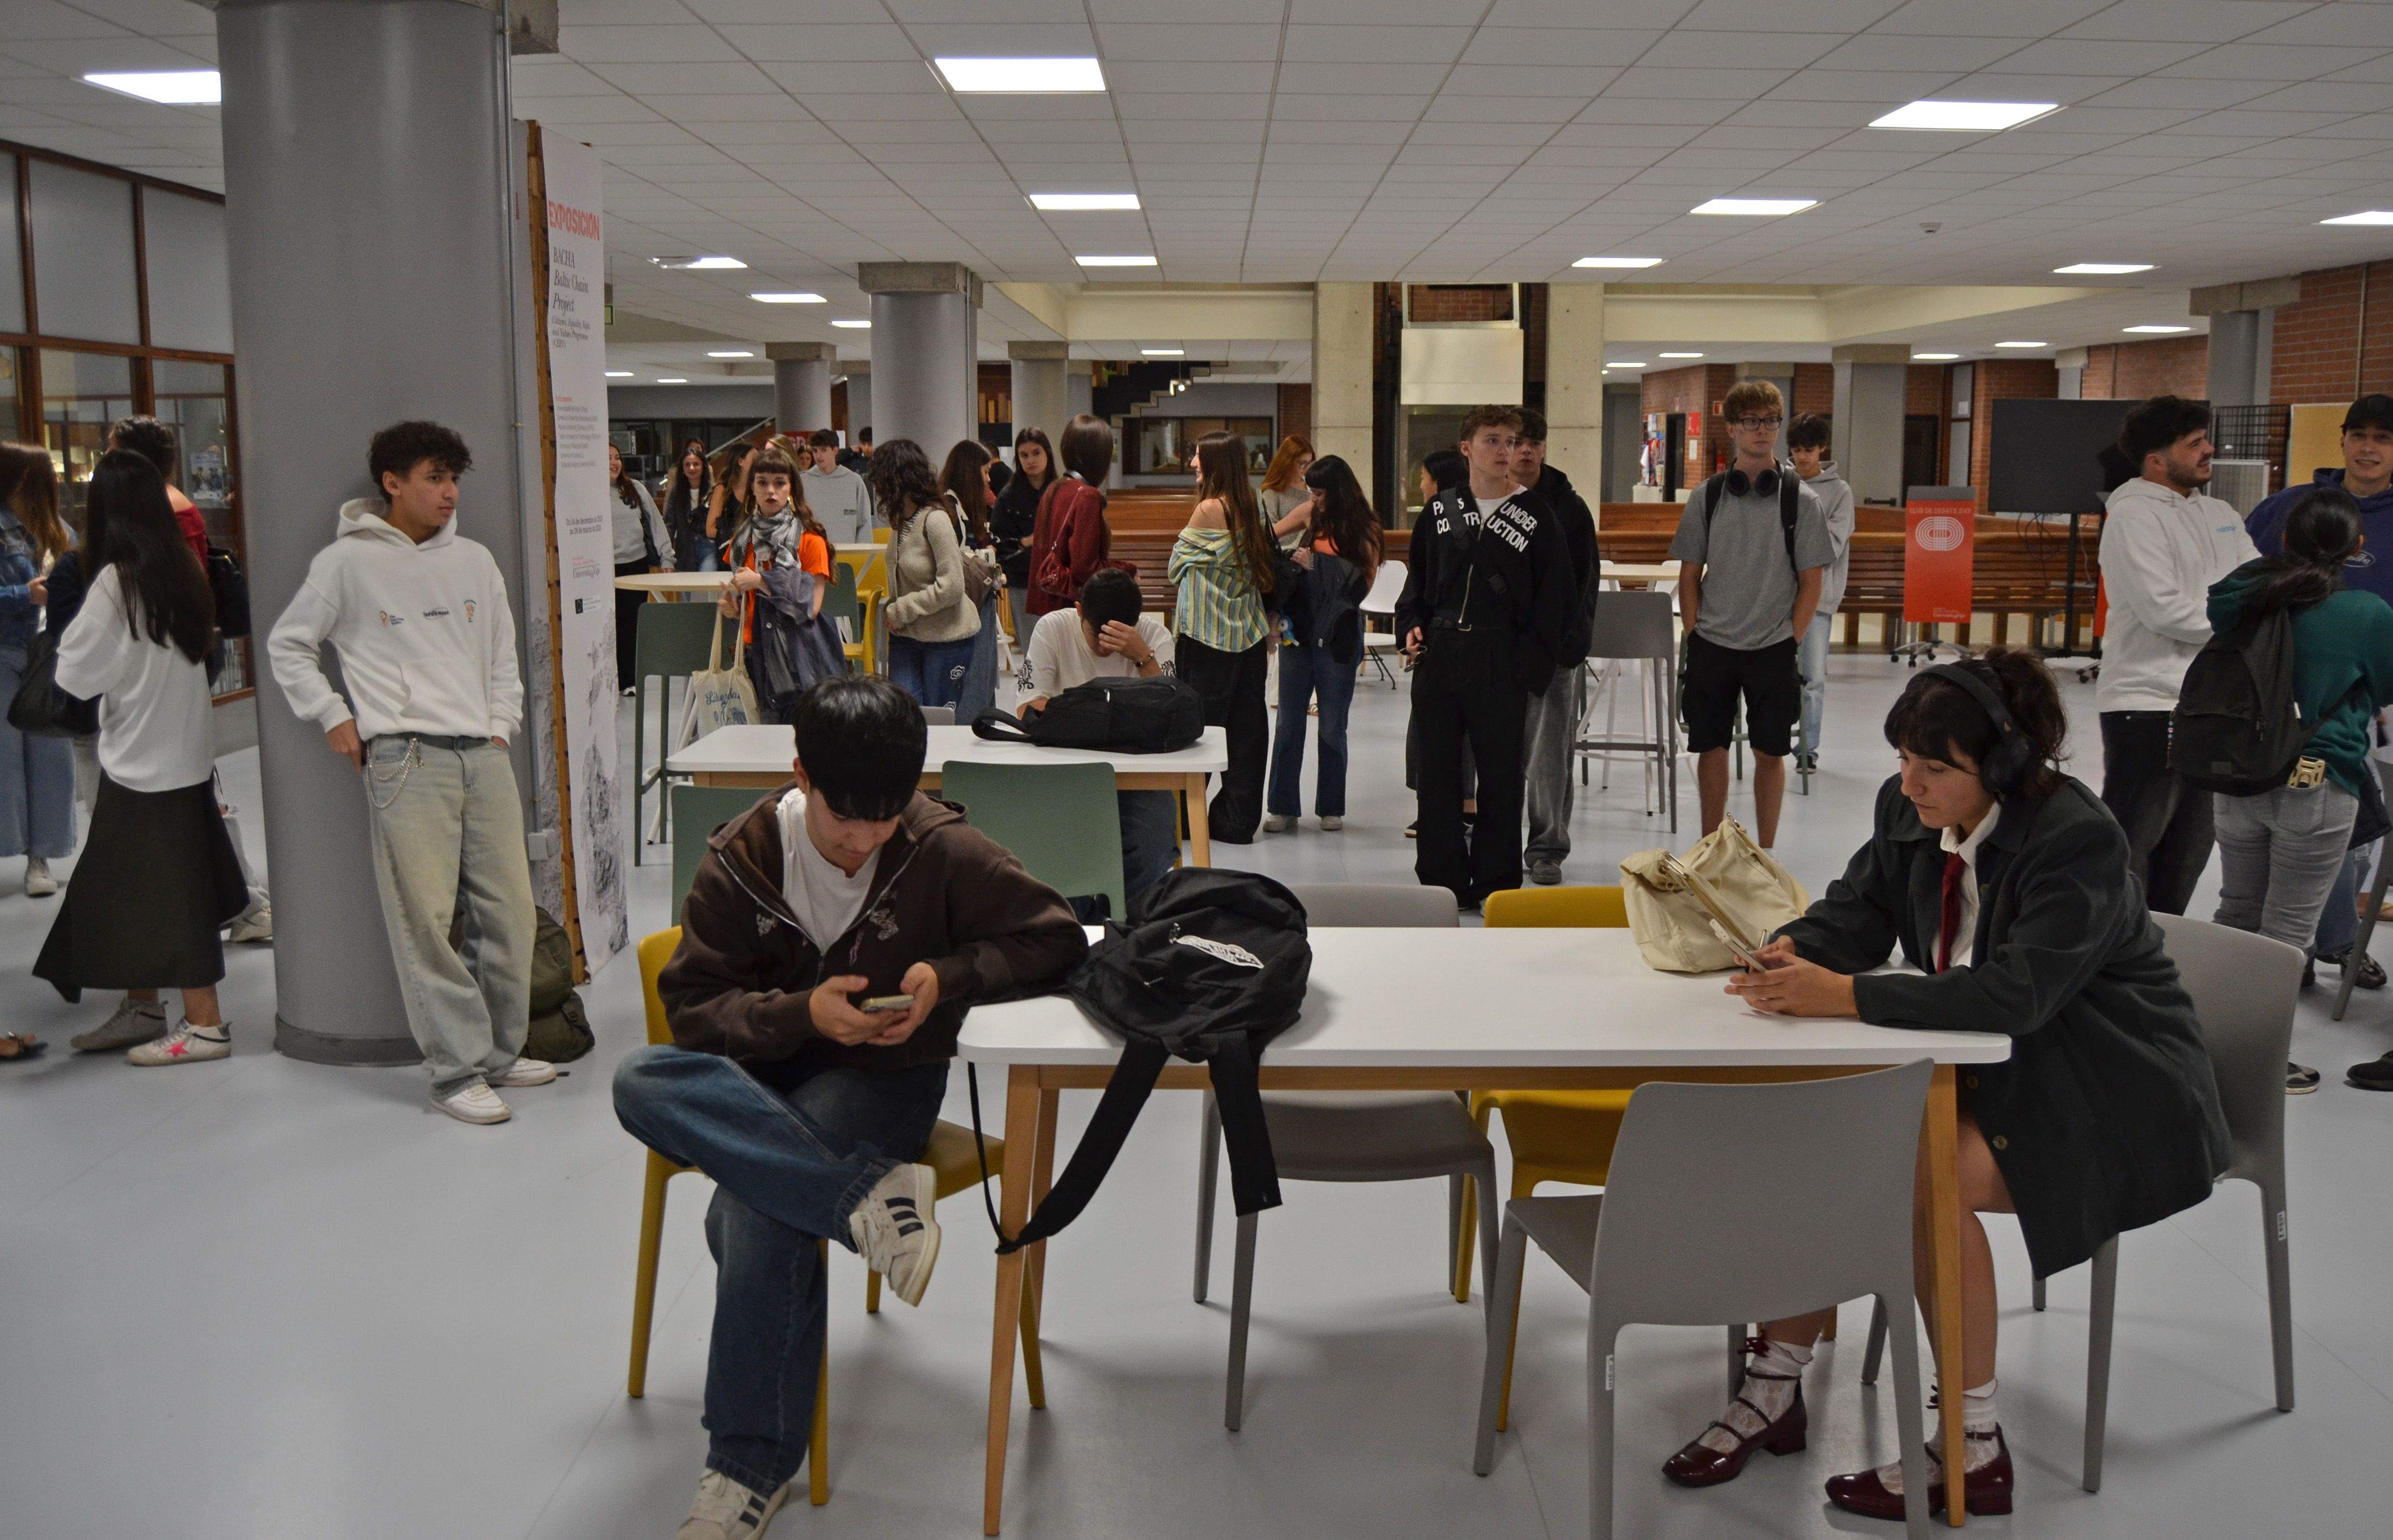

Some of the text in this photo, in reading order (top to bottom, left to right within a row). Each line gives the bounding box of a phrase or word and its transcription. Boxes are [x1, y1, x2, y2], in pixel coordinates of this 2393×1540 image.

[554, 246, 575, 268] BACHA
[553, 293, 574, 316] Project
[1499, 501, 1538, 535] UNDER
